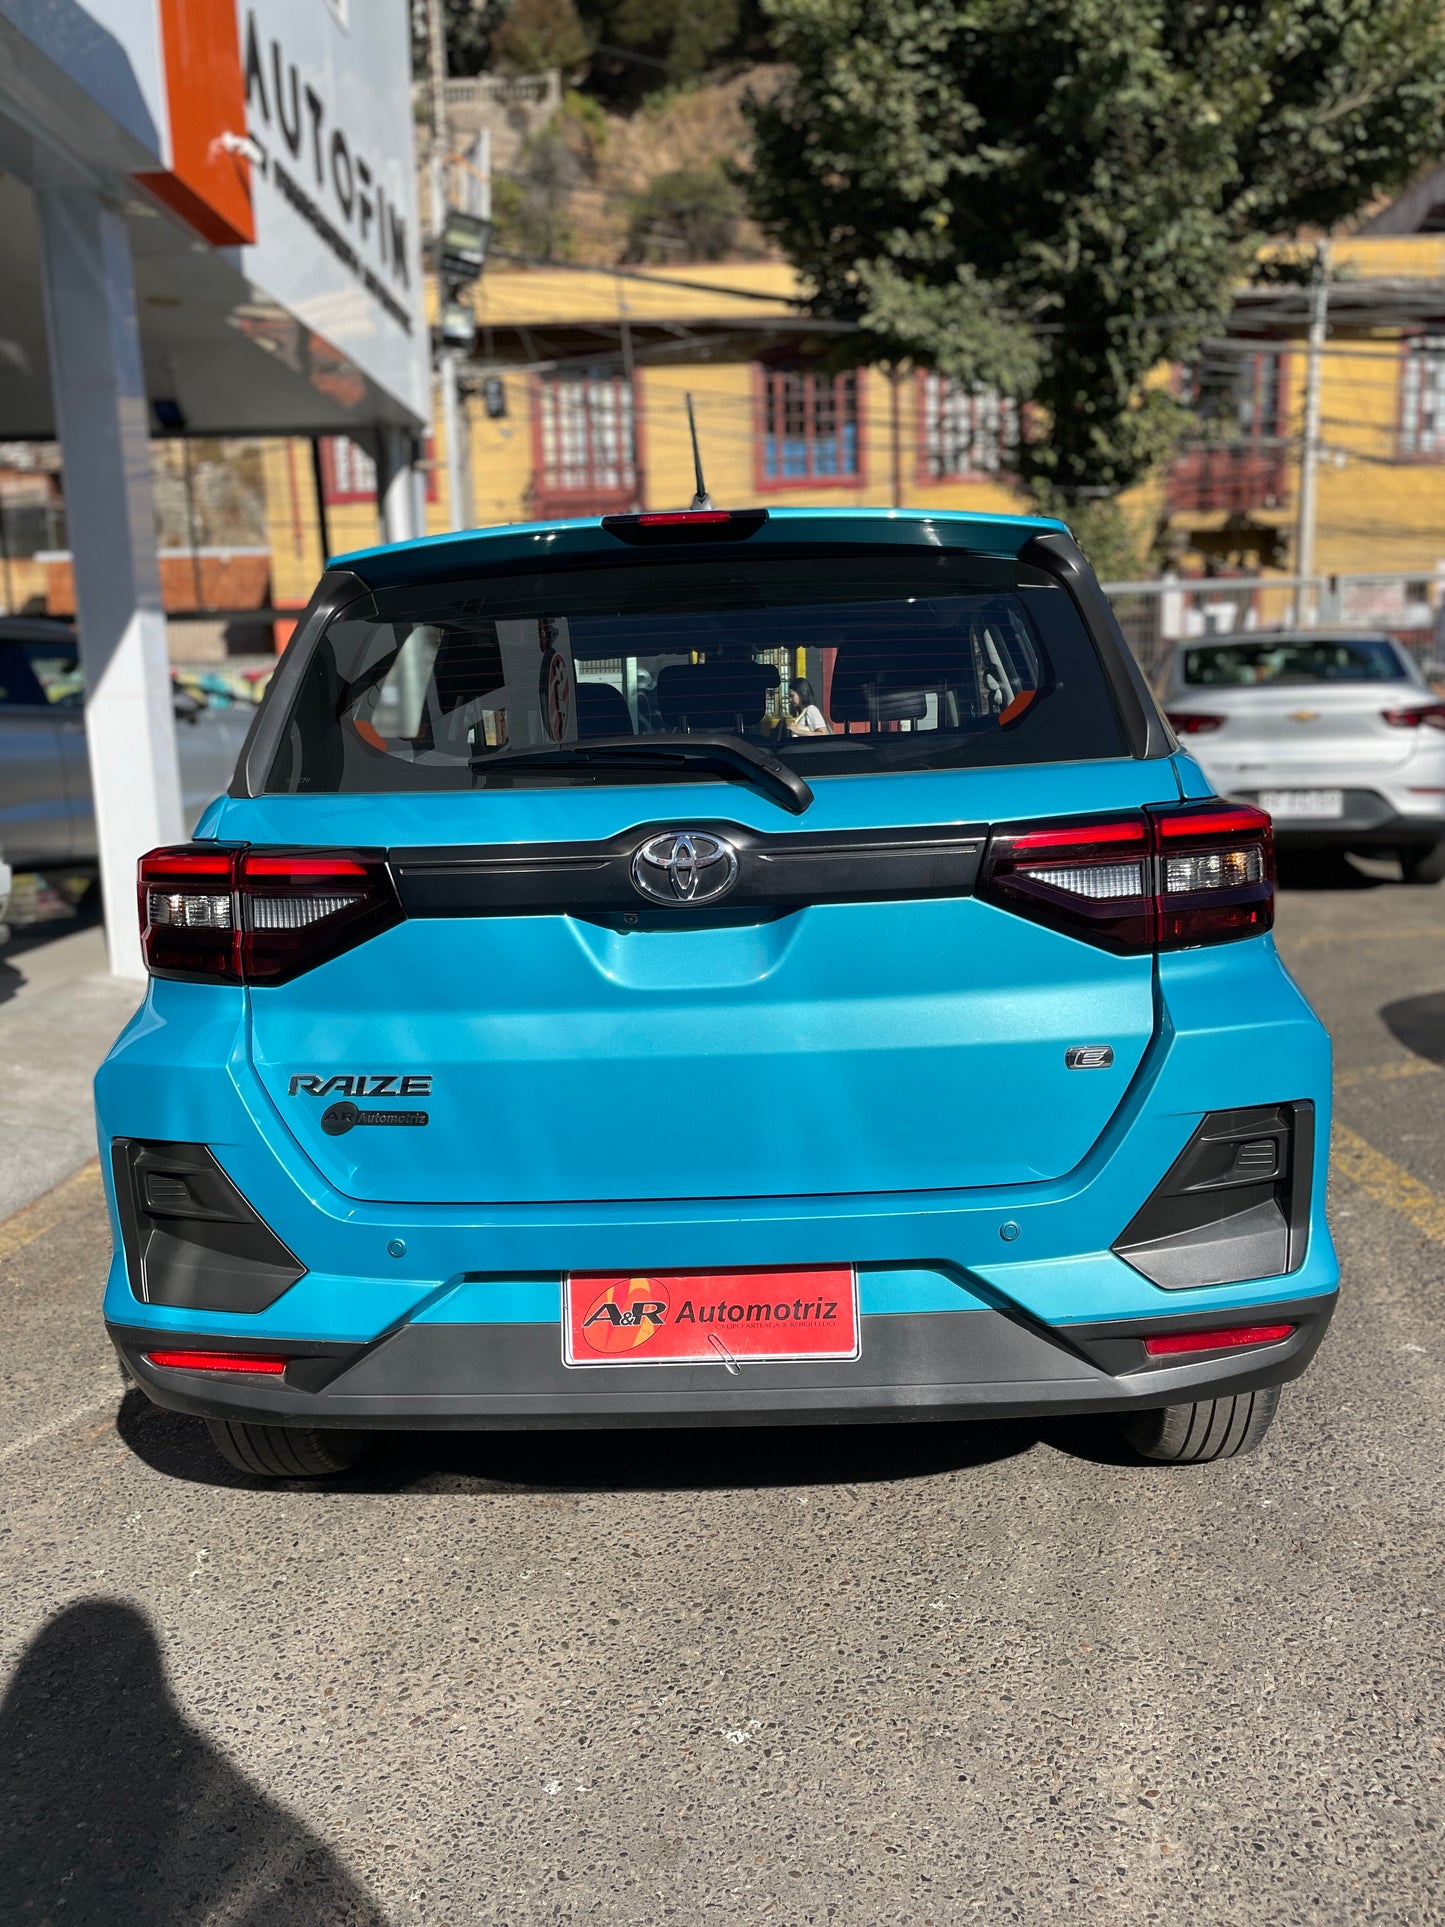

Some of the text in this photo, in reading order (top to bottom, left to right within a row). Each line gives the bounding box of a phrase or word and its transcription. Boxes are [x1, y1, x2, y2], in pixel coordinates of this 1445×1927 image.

[246, 6, 411, 291] AUTOFIN
[288, 1073, 433, 1097] RAIZE
[357, 1112, 426, 1124] Automotriz
[582, 1296, 838, 1328] A&R Automotriz
